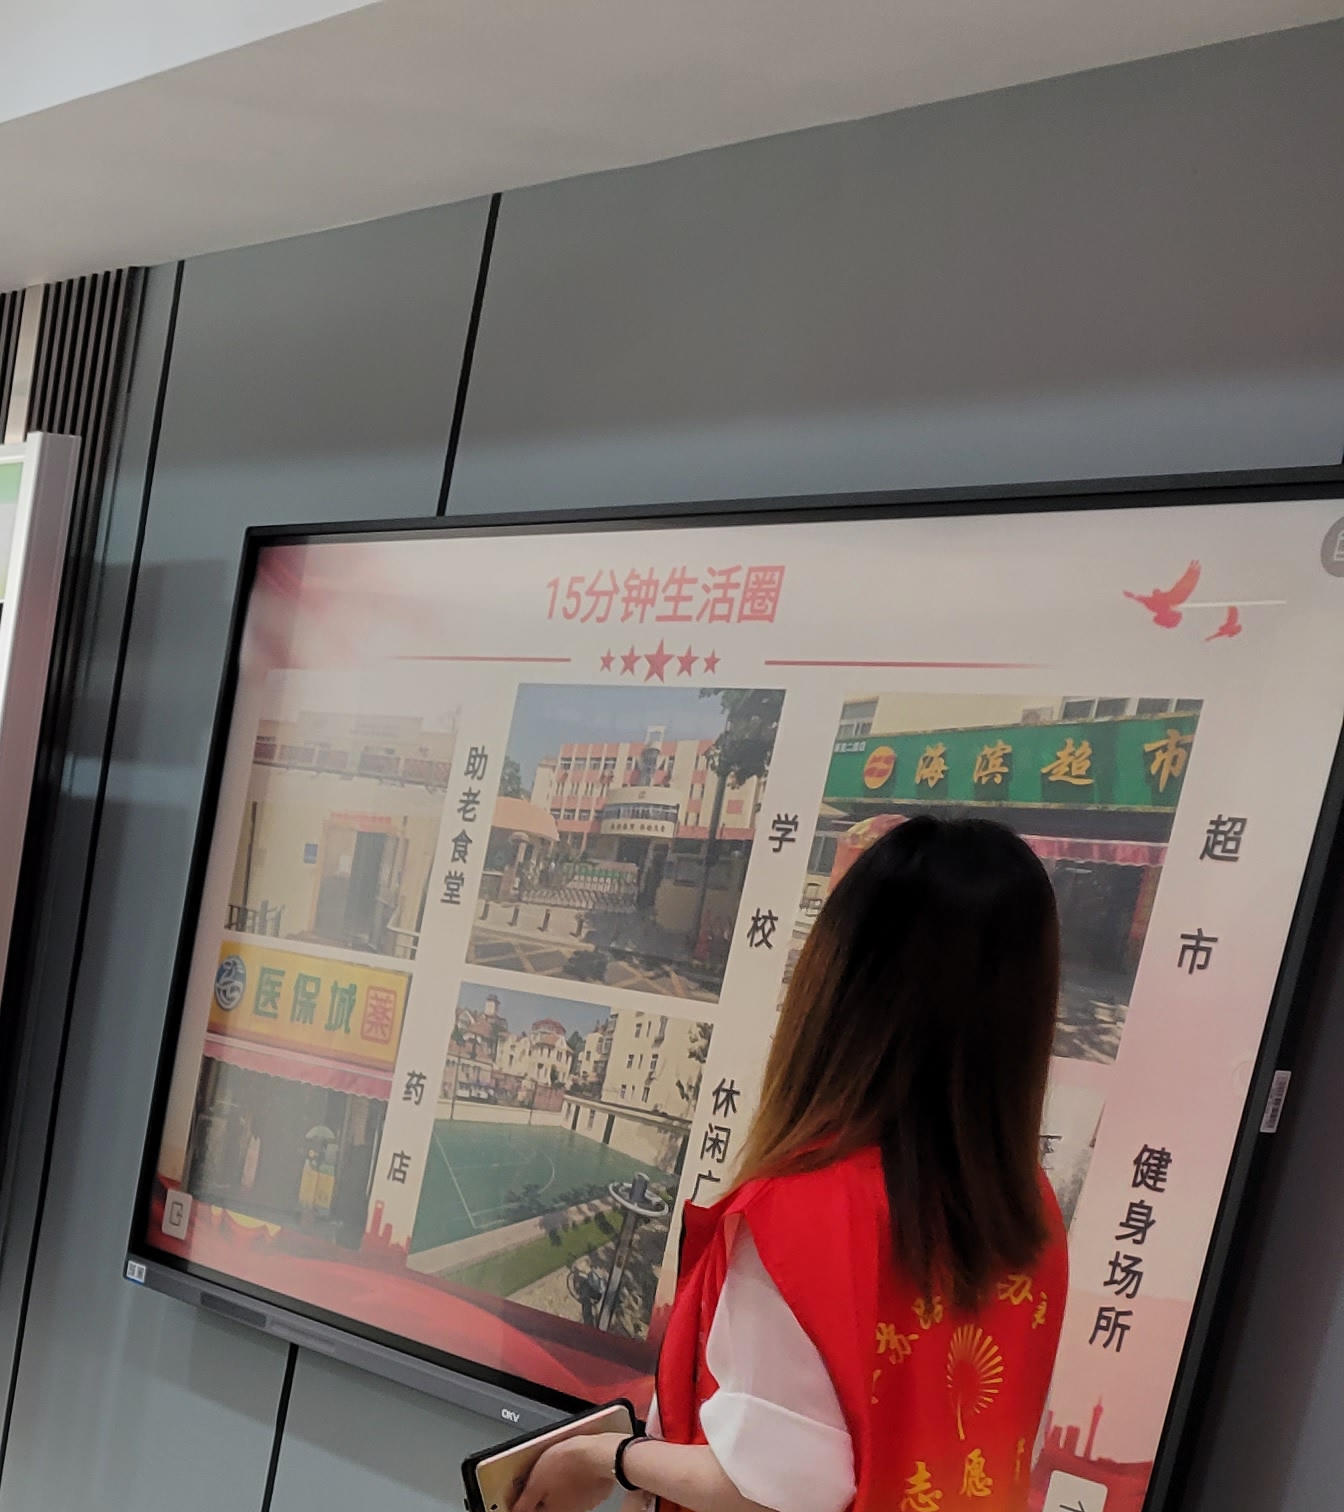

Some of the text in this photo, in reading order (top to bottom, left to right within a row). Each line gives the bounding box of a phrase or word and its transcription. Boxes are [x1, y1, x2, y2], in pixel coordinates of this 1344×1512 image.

[545, 565, 785, 624] 15分钟生活圈
[914, 728, 1194, 792] 海滨超市
[440, 745, 488, 906] 助老食堂
[746, 812, 799, 949] 学校
[1177, 814, 1248, 976] 超市
[252, 966, 358, 1034] 医保城
[386, 1070, 427, 1185] 药店
[1088, 1144, 1172, 1352] 健身场所
